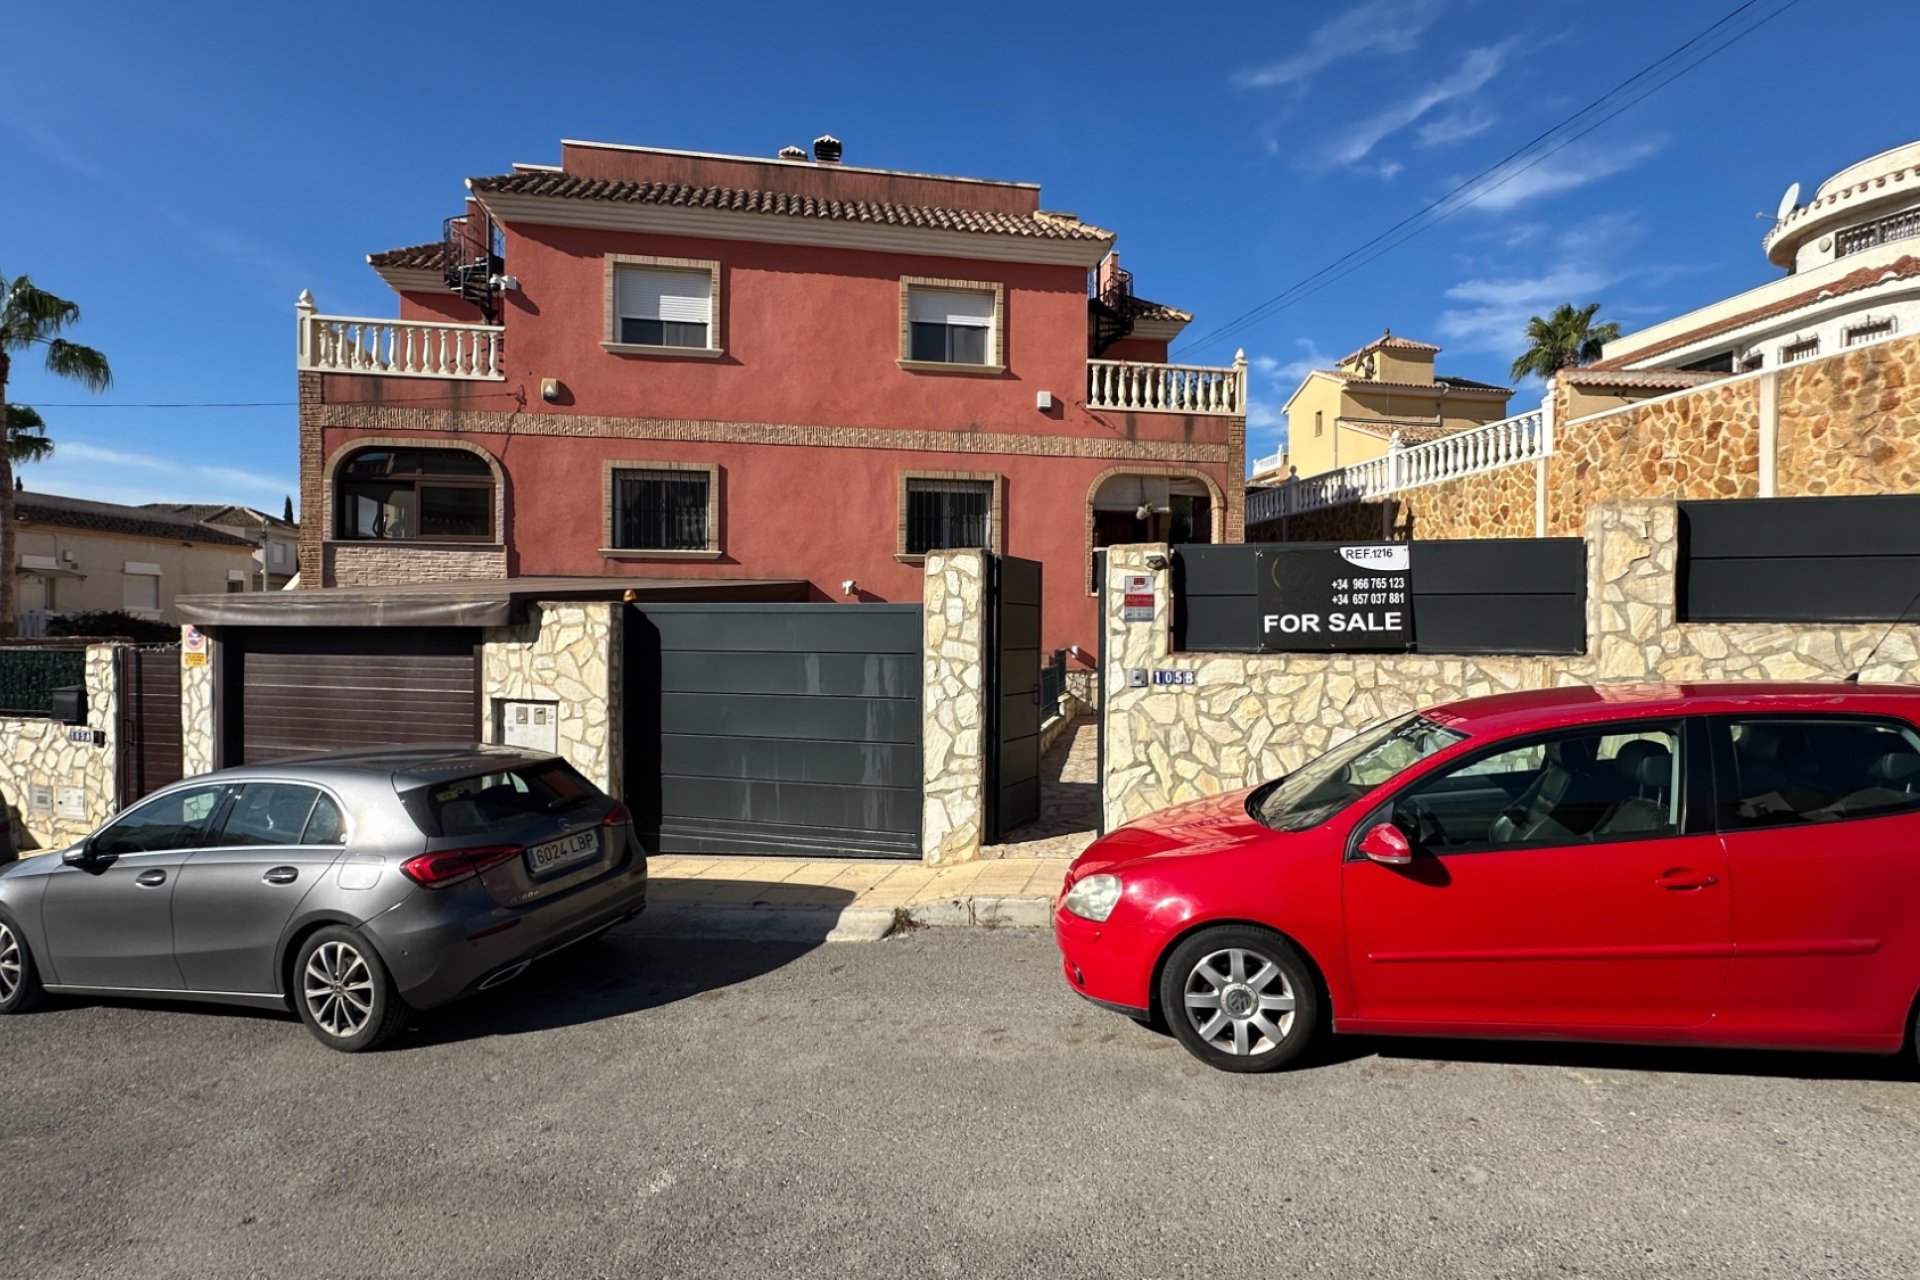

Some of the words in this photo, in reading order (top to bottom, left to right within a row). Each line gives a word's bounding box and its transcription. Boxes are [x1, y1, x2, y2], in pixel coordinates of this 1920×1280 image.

[1345, 548, 1393, 559] REF.1216
[1331, 579, 1349, 590] +34
[1352, 578, 1369, 589] 966
[1371, 578, 1387, 589] 765
[1389, 577, 1405, 588] 123
[1331, 594, 1349, 605] +34
[1352, 593, 1369, 605] 657
[1371, 593, 1387, 604] 037
[1389, 592, 1405, 604] 881
[1264, 613, 1321, 633] FOR
[1328, 611, 1403, 632] SALE
[536, 842, 567, 865] 6024
[570, 833, 594, 853] LBP
